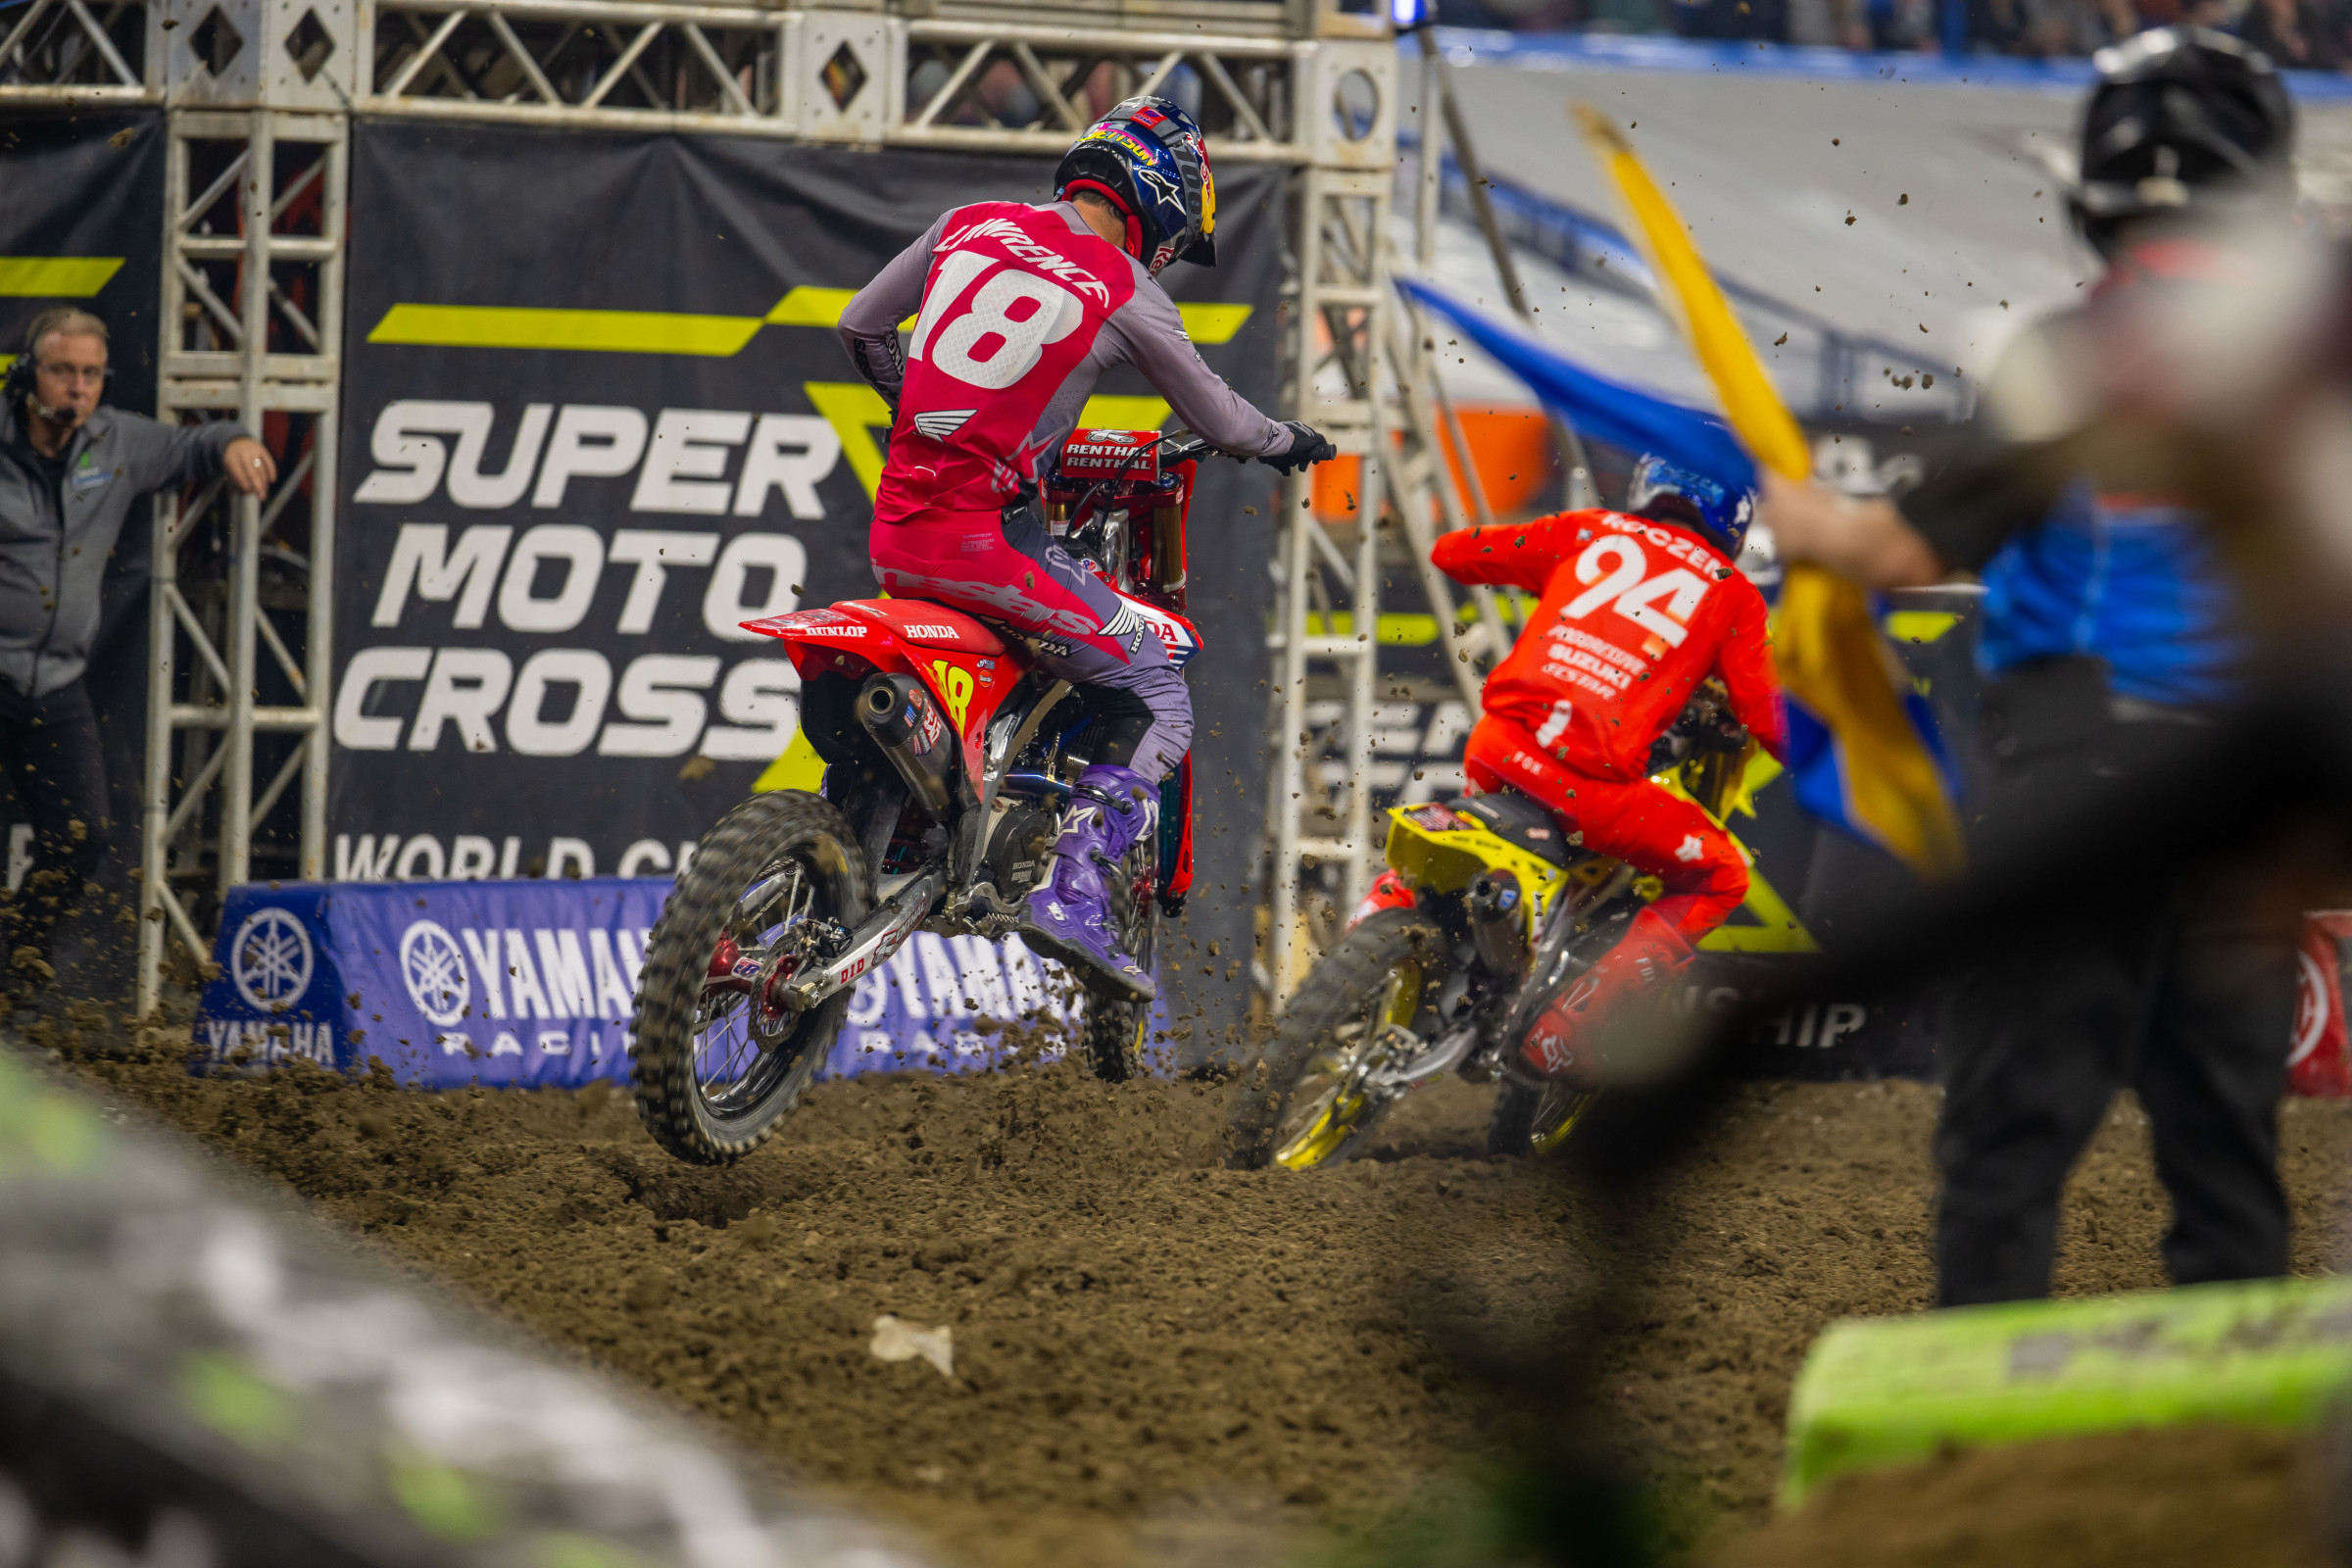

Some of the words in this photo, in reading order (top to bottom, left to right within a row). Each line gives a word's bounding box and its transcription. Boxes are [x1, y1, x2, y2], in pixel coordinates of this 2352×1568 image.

[932, 219, 1109, 309] LAWRENCE
[908, 250, 1084, 390] 18
[354, 399, 840, 519] SUPER
[1066, 444, 1152, 458] RENTHAL
[1066, 458, 1152, 470] RENTHAL
[372, 523, 807, 642] MOTO
[1559, 534, 1709, 649] 94
[805, 625, 867, 638] DUNLOP
[904, 625, 959, 639] HONDA
[1547, 643, 1632, 690] SUZUKI
[334, 647, 802, 761] CROSS
[334, 833, 596, 880] WORLD
[441, 1031, 636, 1056] RACI
